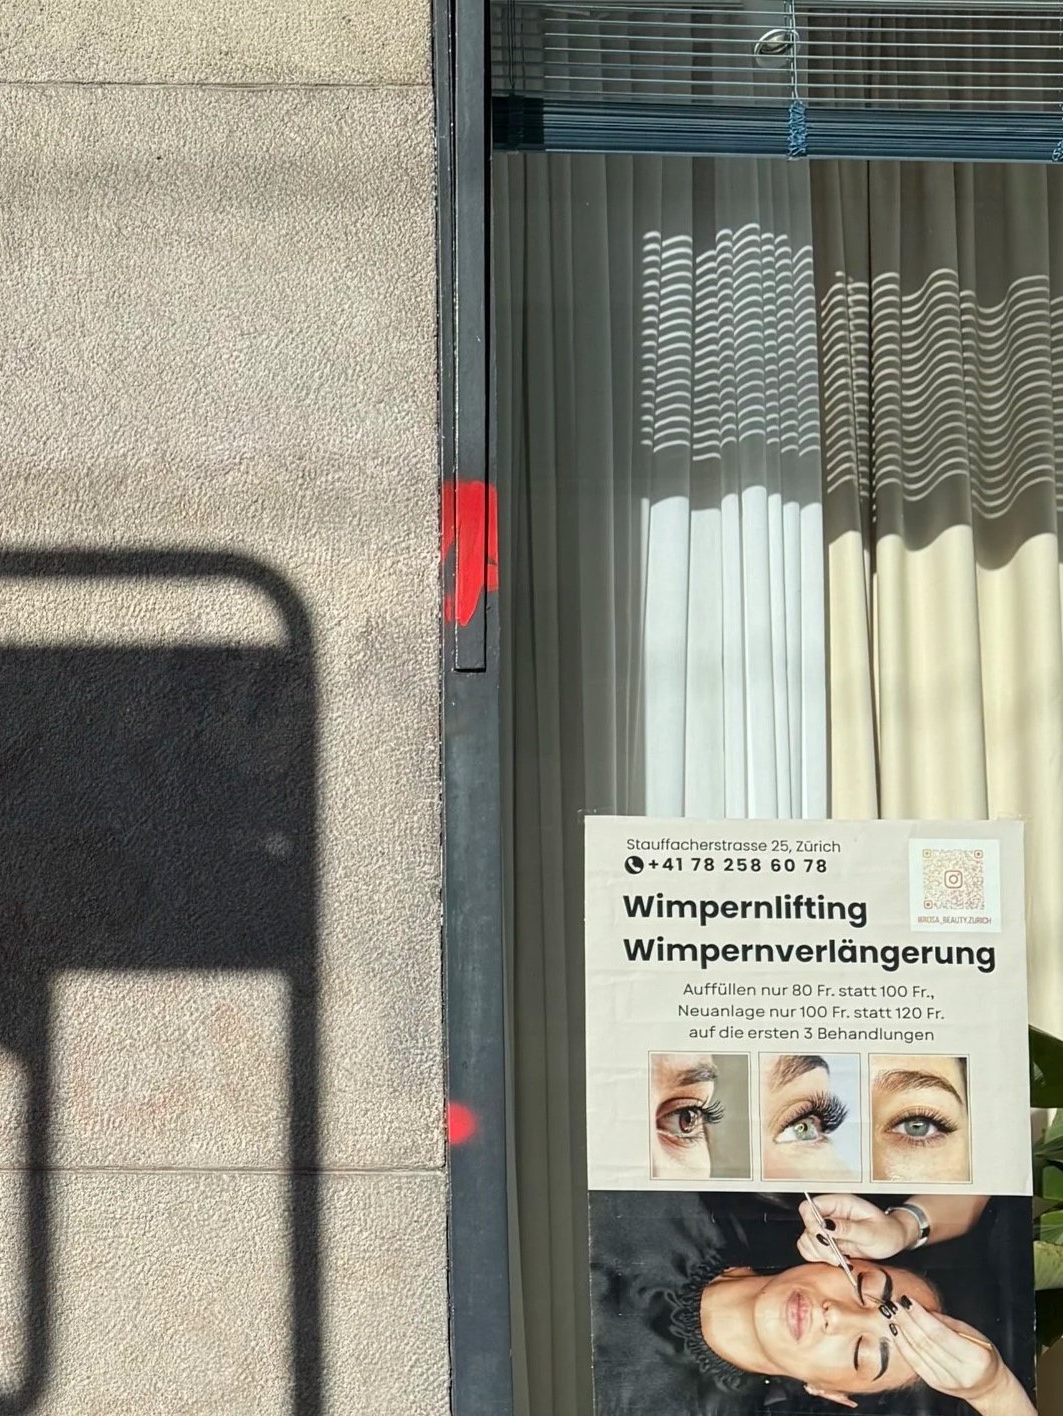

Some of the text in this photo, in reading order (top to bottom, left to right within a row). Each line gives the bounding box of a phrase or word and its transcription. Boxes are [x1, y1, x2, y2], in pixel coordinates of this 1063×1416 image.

[626, 838, 840, 853] Stauffacherstrasse 25, Zürich
[648, 857, 826, 873] +41 78 258 60 78
[623, 893, 866, 928] Wimpernlifting
[624, 936, 995, 973] Wimpernverlängerung
[682, 982, 934, 999] Auffüllen nur 80 Fr. statt 100 Fr.,
[678, 1004, 944, 1020] Neuanlage nur 100 Fr. statt 120 Fr.
[688, 1025, 934, 1043] auf die ersten 3 Behandlungen
